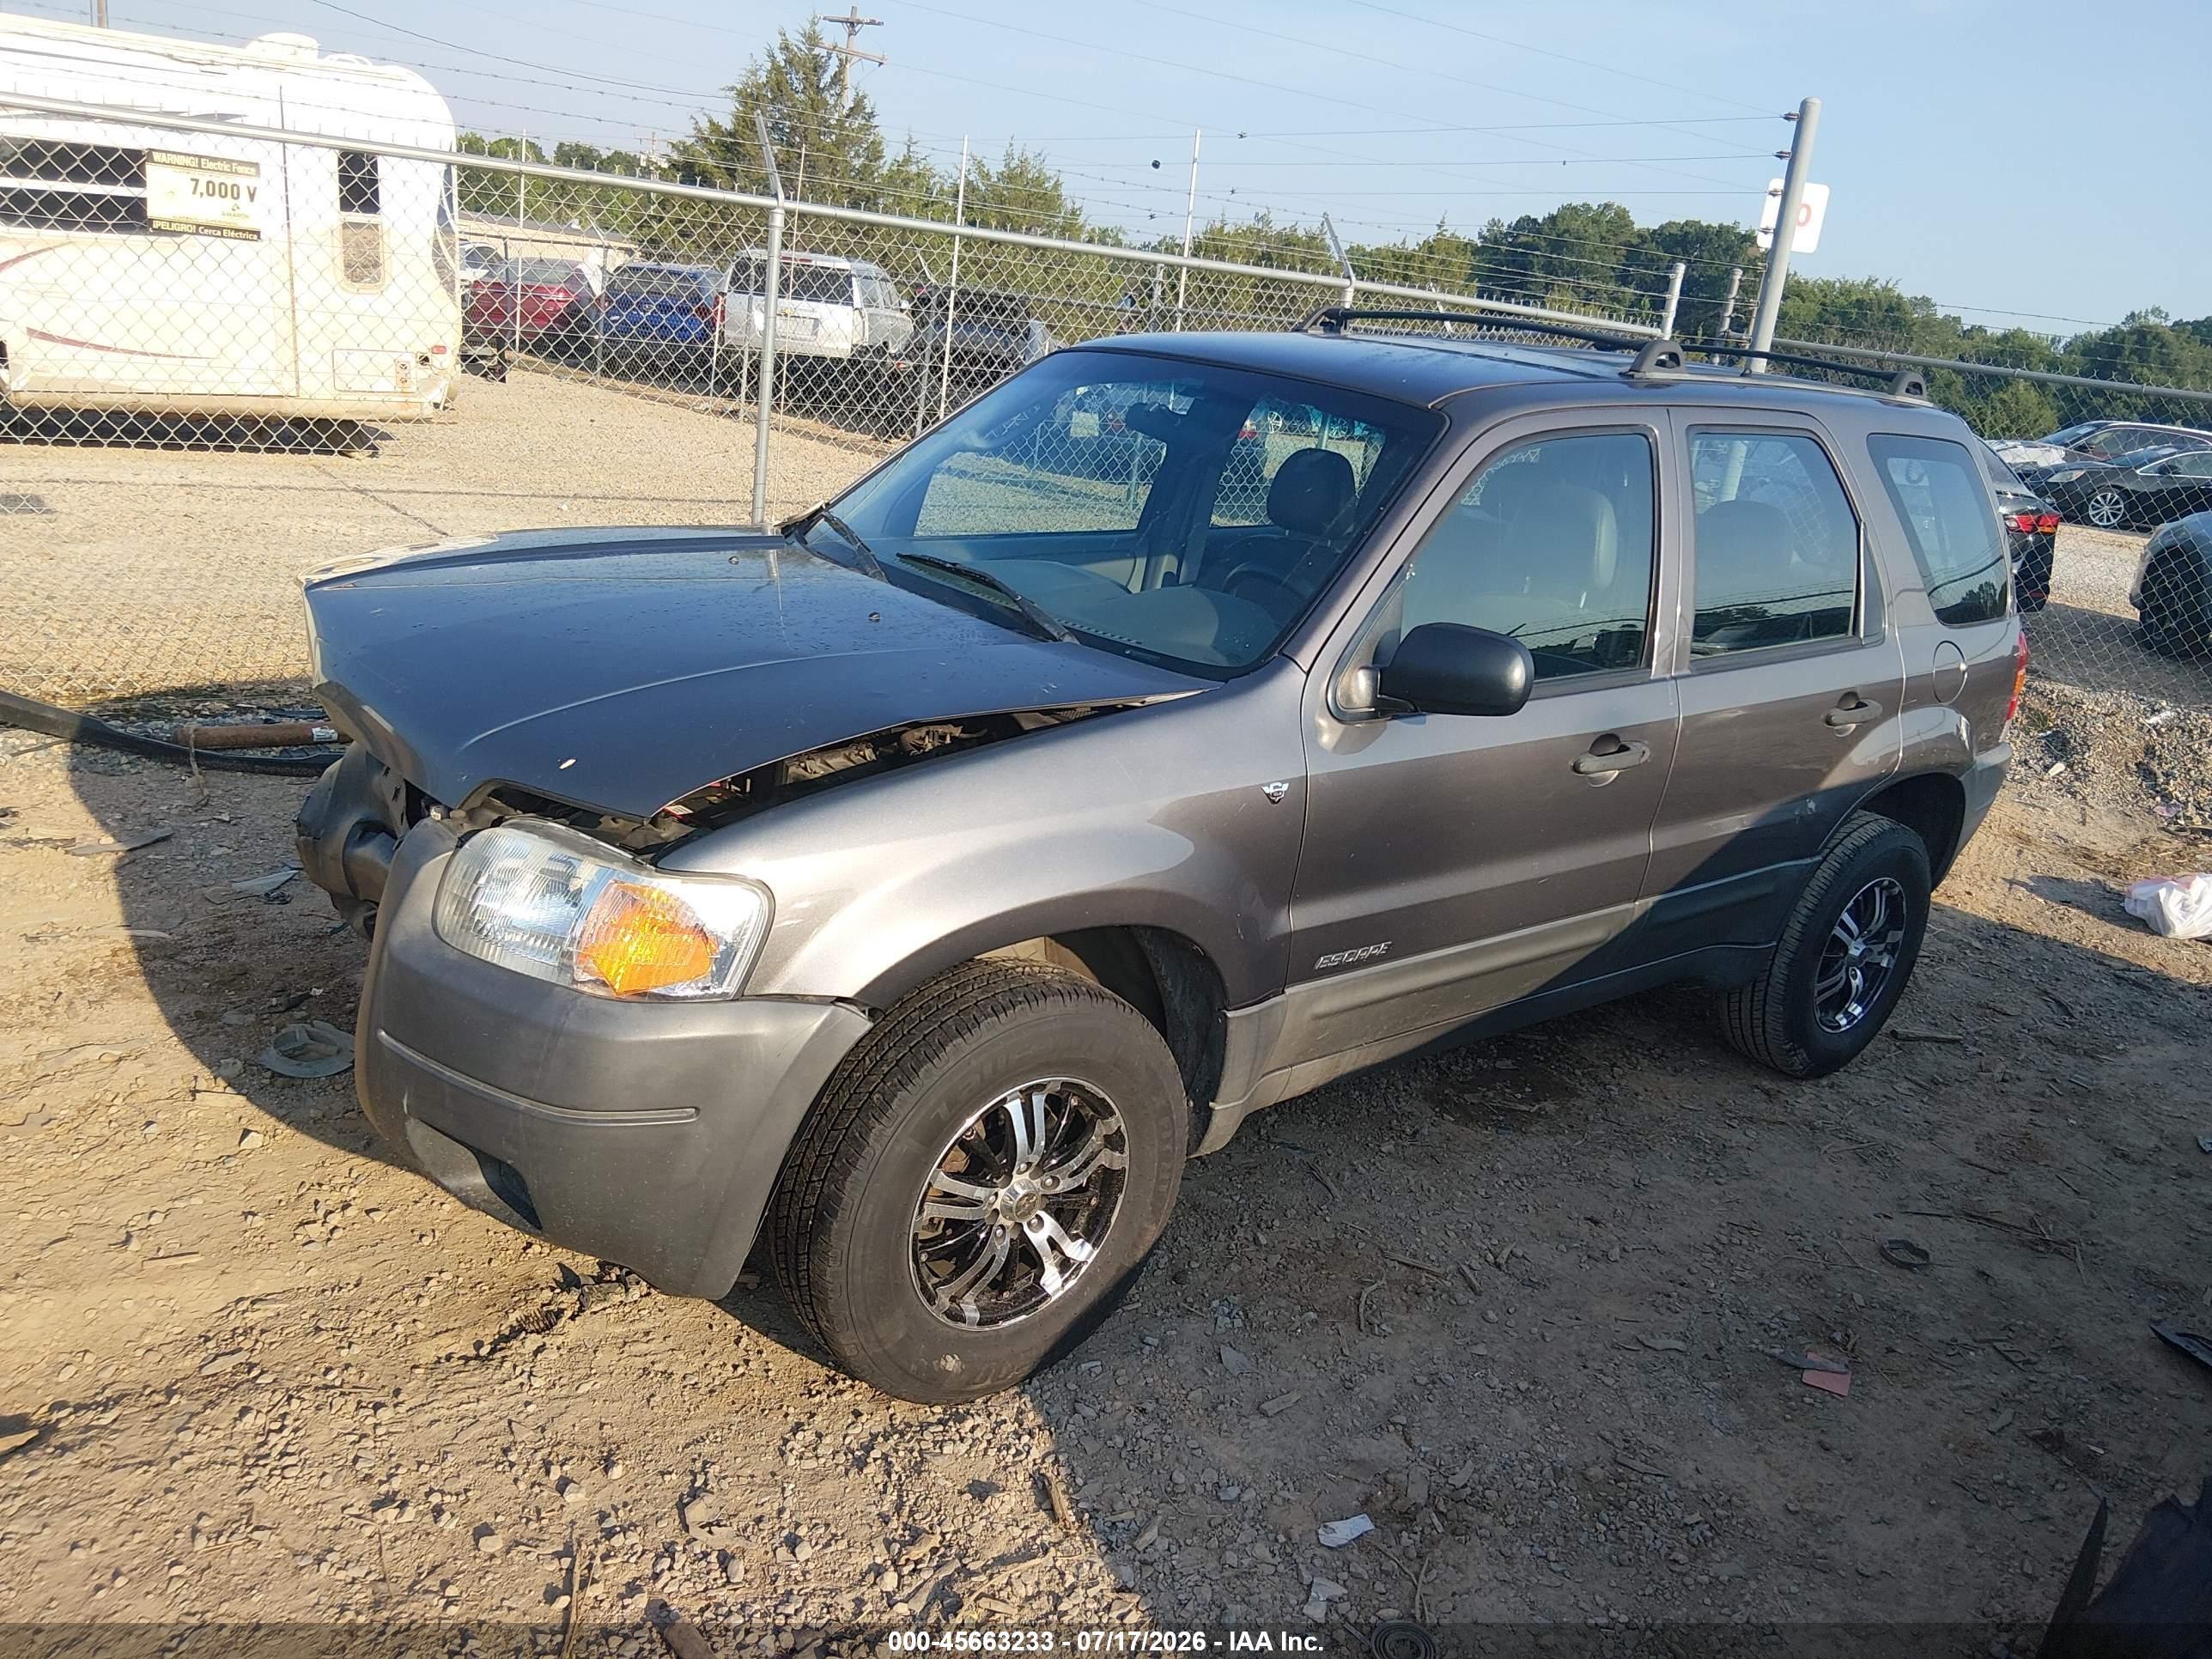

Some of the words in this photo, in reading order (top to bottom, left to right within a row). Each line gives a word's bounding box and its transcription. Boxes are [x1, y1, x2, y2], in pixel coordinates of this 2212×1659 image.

[152, 151, 199, 168] WARNING!
[201, 158, 232, 173] Electric
[233, 163, 256, 175] Fence
[190, 178, 240, 200] 7,000
[246, 185, 258, 203] V
[152, 220, 197, 234] ¡PELIGRO!
[198, 226, 222, 237] Cerca
[222, 228, 258, 240] Eléctrica
[1314, 940, 1393, 970] ESCAPE
